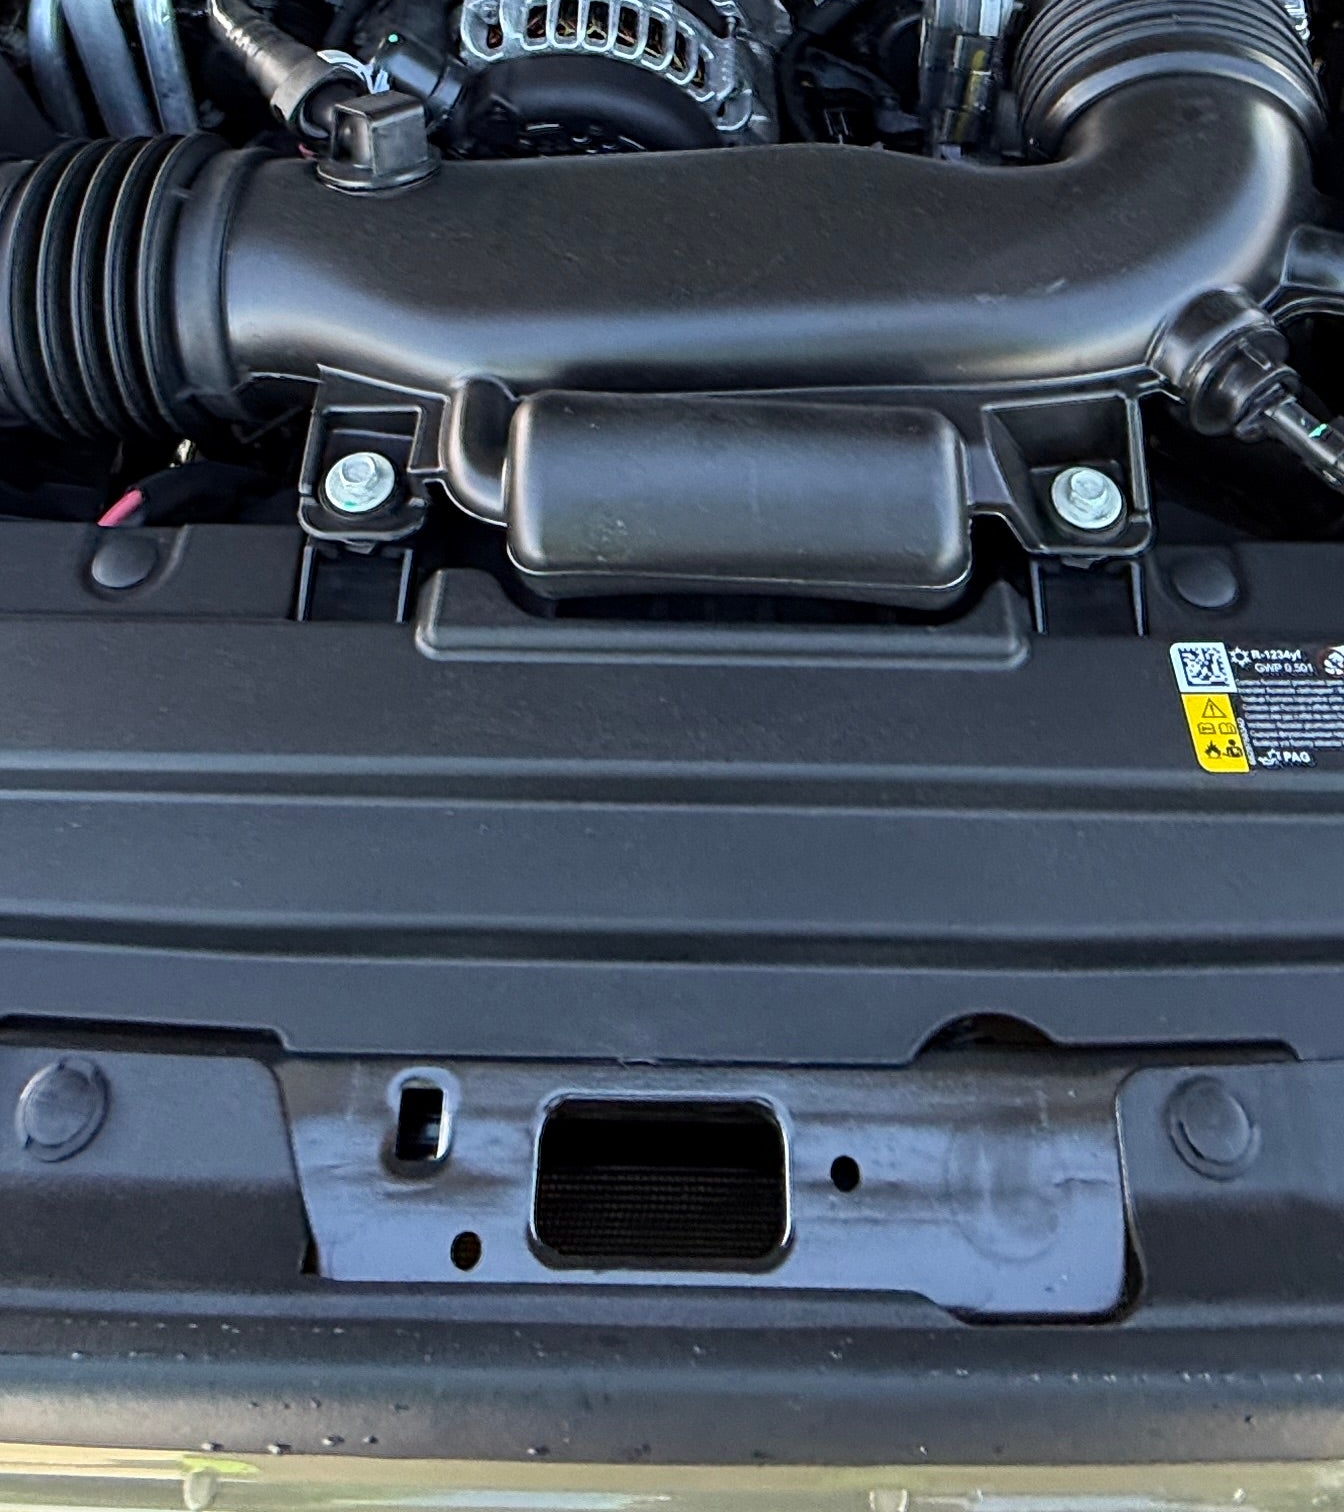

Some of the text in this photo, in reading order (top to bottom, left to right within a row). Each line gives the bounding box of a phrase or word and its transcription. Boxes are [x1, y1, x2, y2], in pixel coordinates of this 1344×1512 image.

[1254, 662, 1314, 673] GWP 0.501
[1282, 751, 1311, 763] PAG
